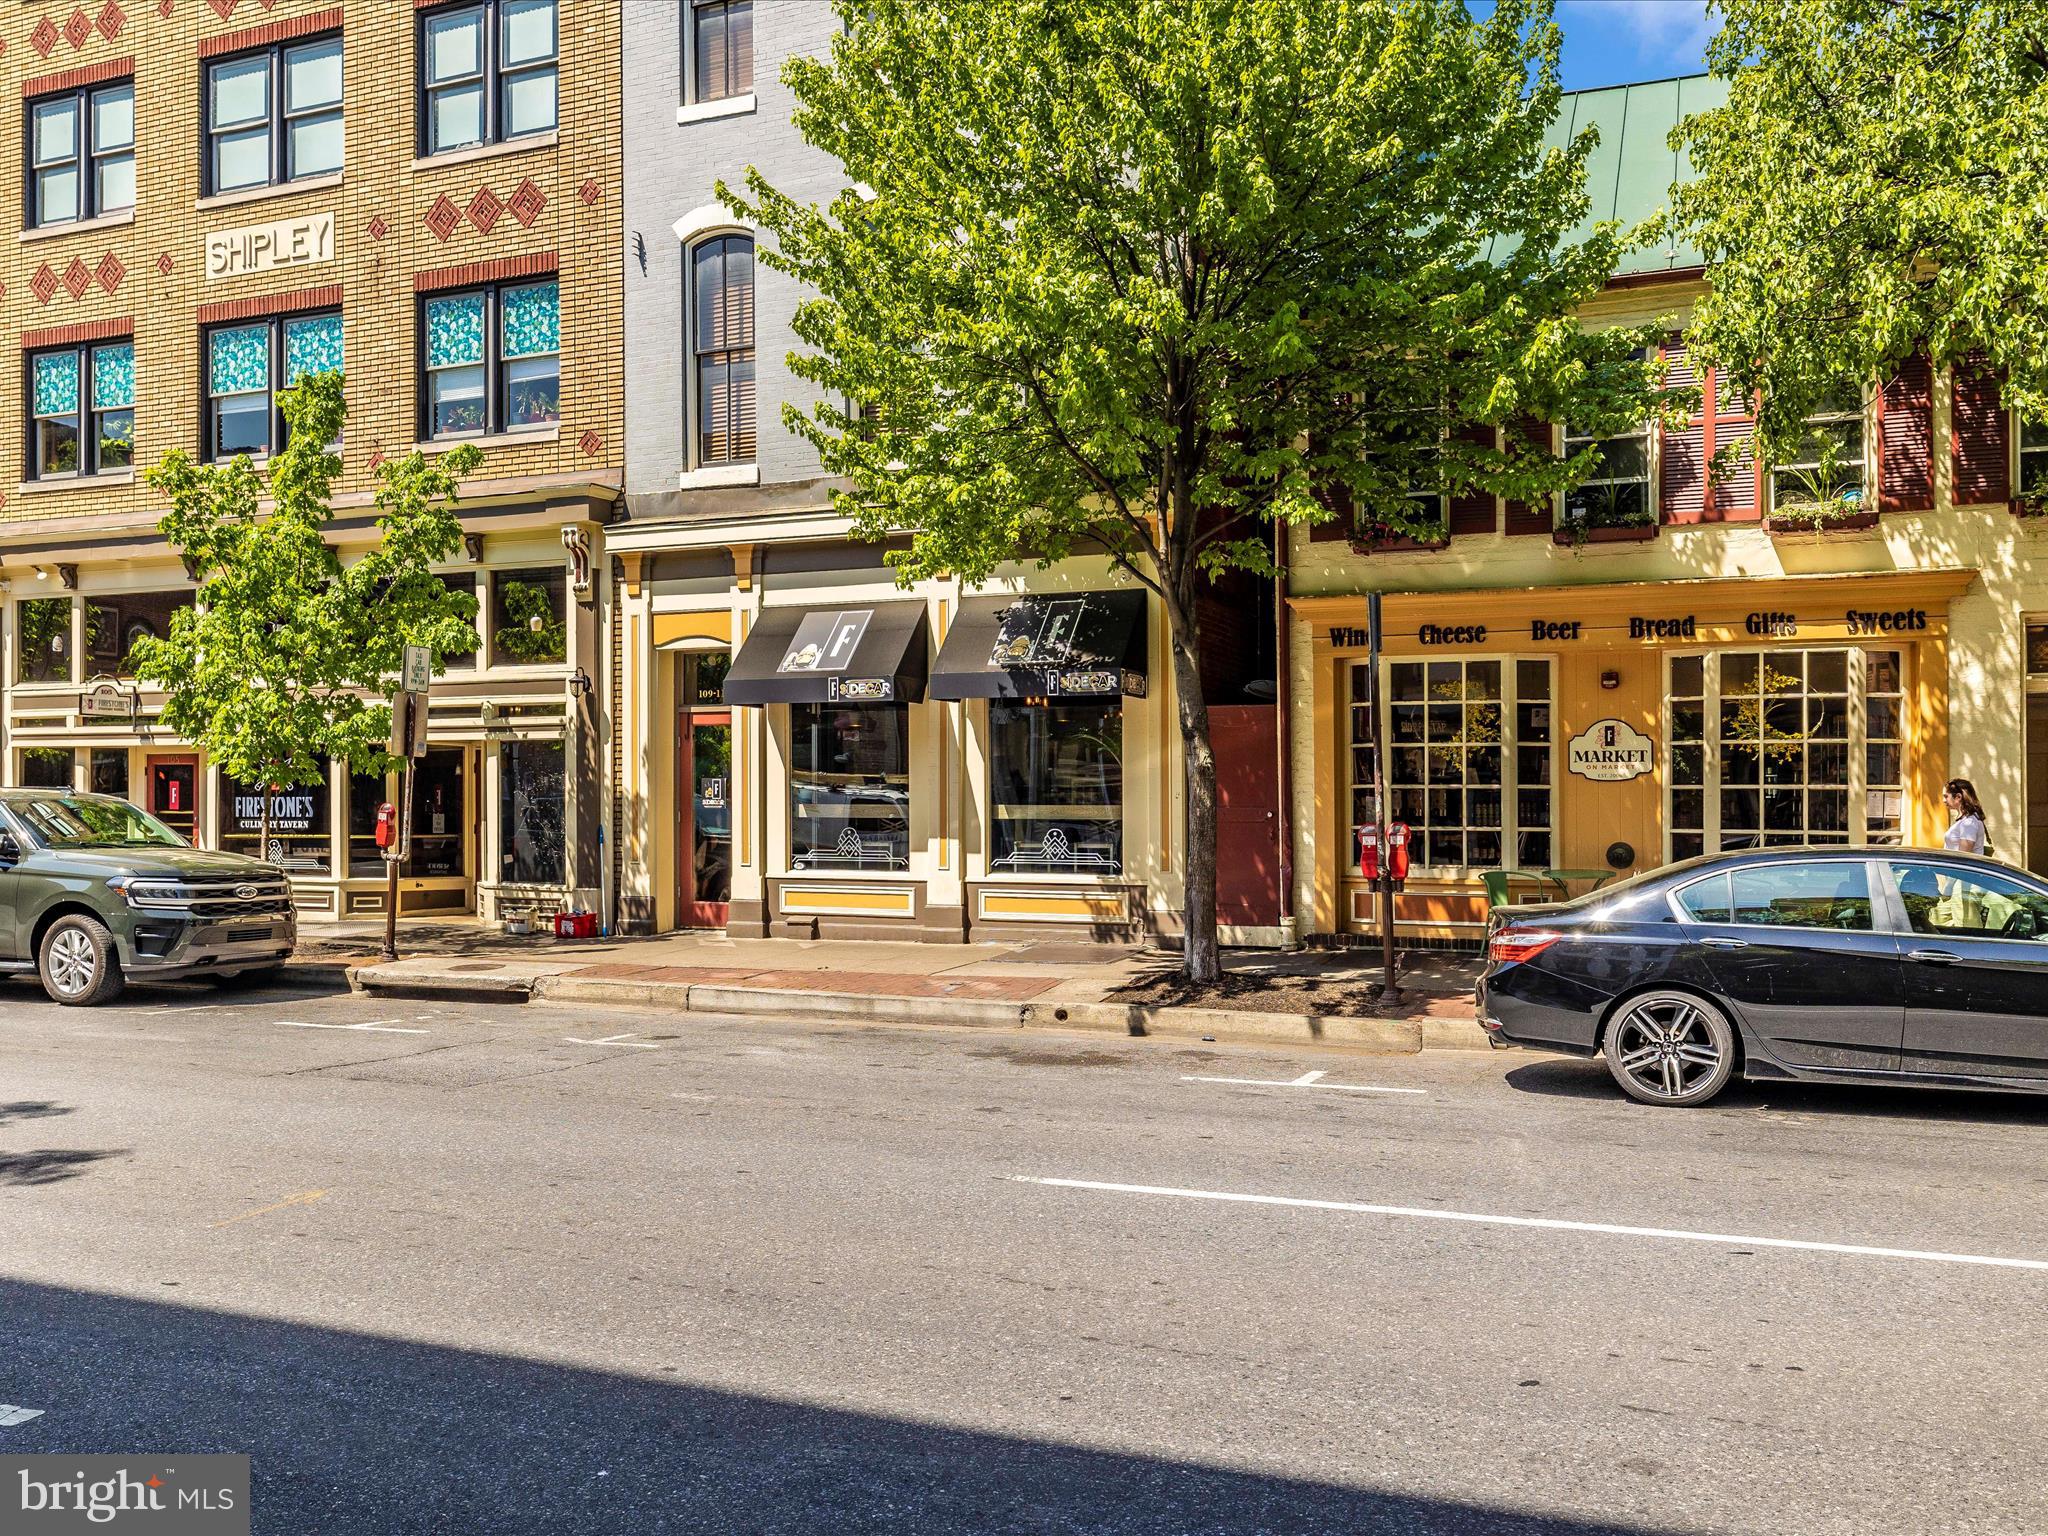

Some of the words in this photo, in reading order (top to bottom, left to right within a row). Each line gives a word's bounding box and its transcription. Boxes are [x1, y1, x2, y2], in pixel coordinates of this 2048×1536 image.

[211, 220, 329, 274] SHIPLEY
[1418, 624, 1487, 645] Cheese
[1531, 620, 1582, 640] Beer
[1629, 615, 1696, 639] Bread
[1745, 612, 1797, 635] Gifts
[1846, 608, 1926, 635] Sweets
[829, 624, 857, 657] F
[839, 682, 891, 695] SIDECAR
[1060, 675, 1118, 689] SIDECAR
[1574, 750, 1648, 763] MARKET
[240, 820, 278, 829] CULINRY
[280, 820, 309, 829] TAVERN
